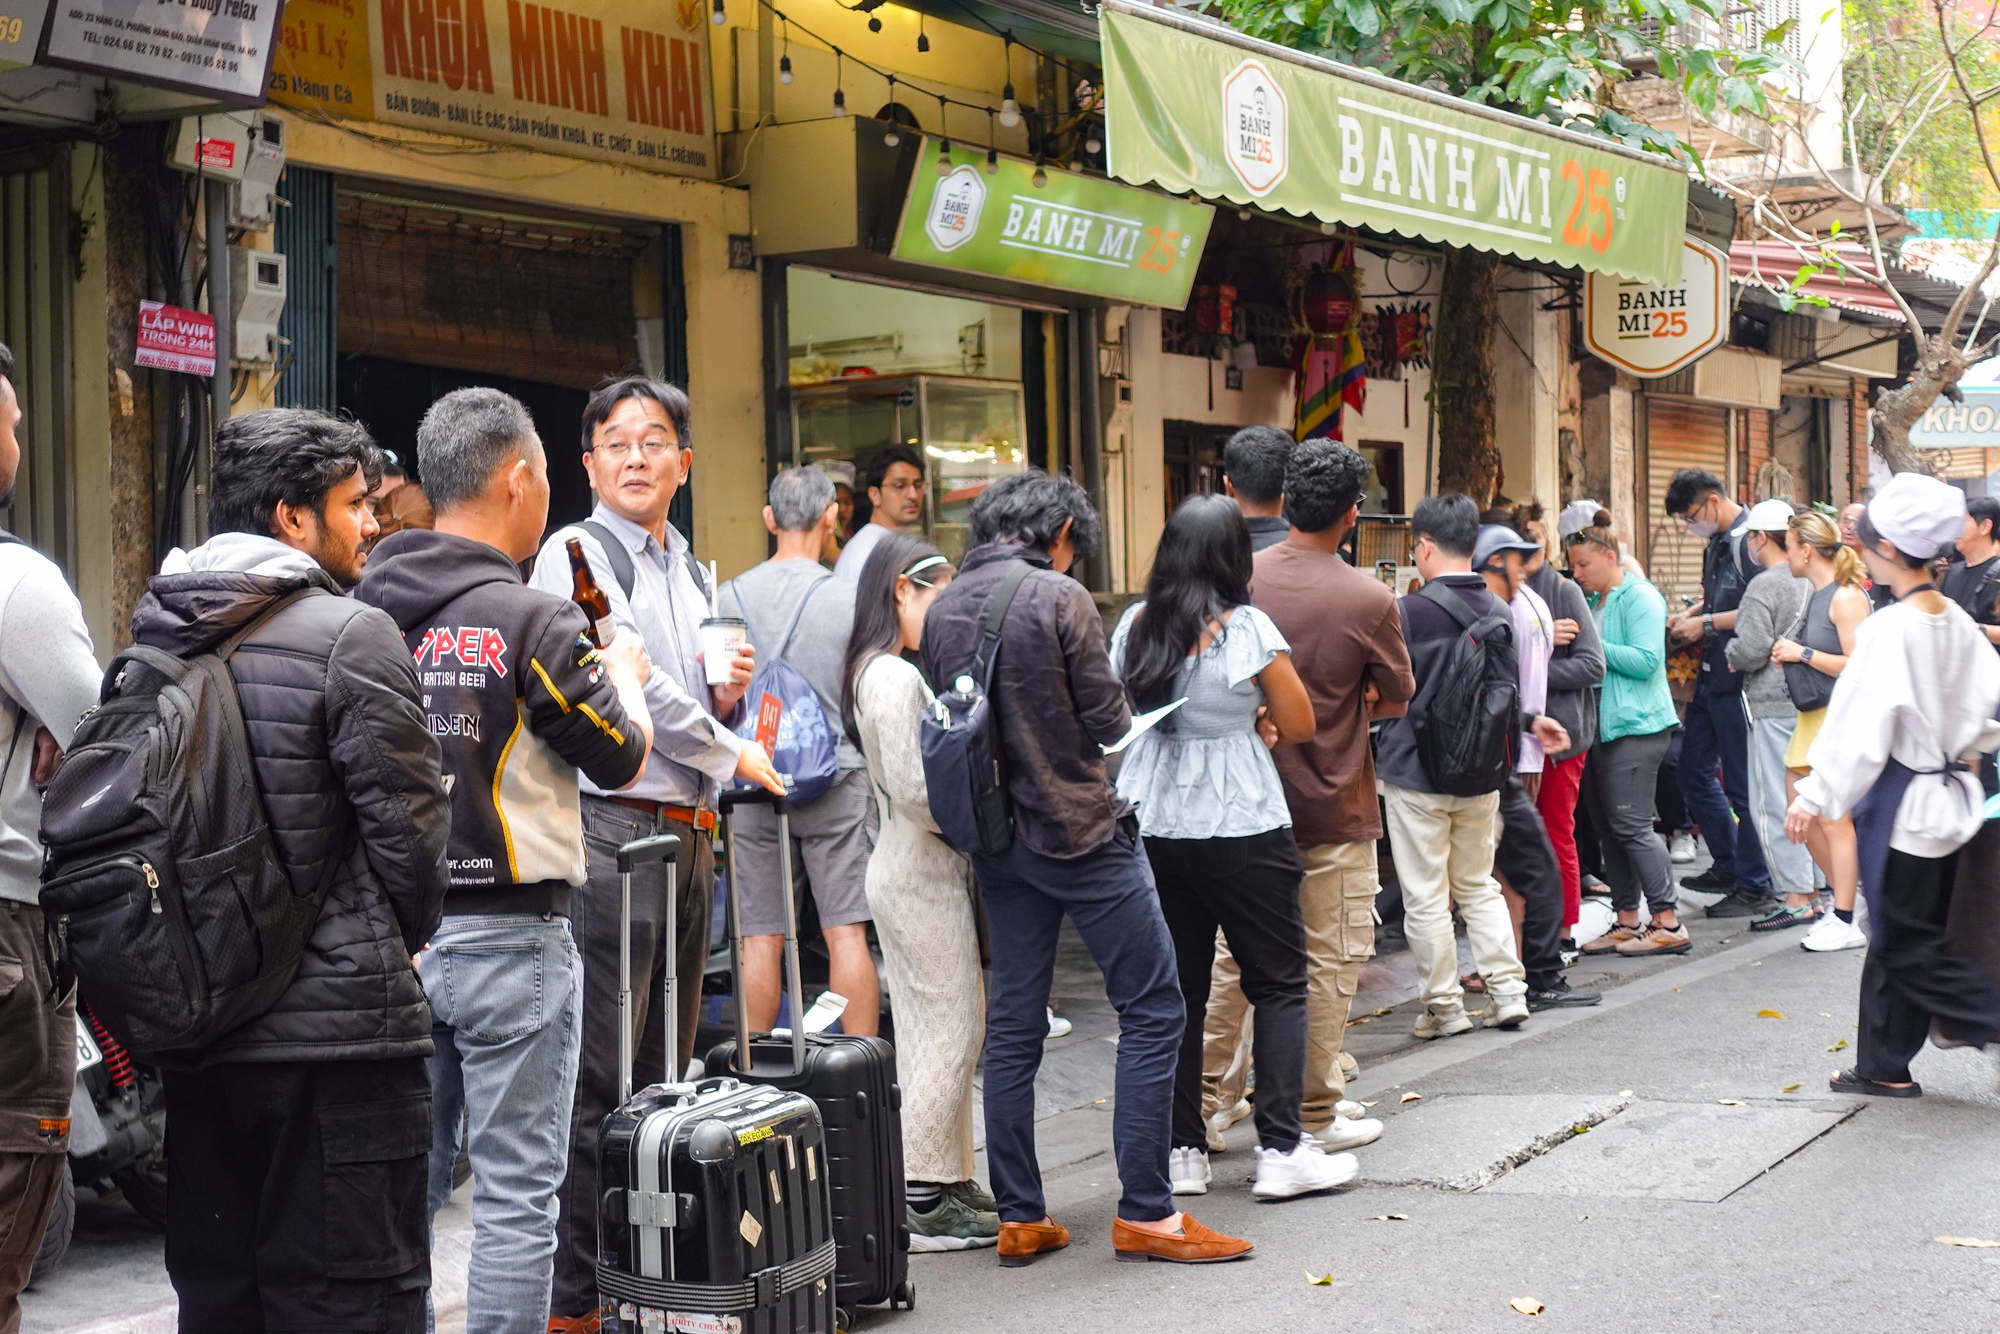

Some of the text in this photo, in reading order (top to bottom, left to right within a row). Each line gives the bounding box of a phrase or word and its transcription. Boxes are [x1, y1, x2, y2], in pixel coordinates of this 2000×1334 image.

[225, 0, 257, 20] relax
[83, 30, 100, 45] TEL:
[279, 19, 308, 59] ại
[506, 0, 609, 117] MINH
[621, 25, 704, 135] KHAI
[269, 72, 288, 91] 25
[1240, 113, 1271, 137] BANH
[1338, 113, 1477, 212] BANH
[1496, 155, 1552, 228] MI
[1561, 158, 1613, 254] 25
[944, 199, 971, 215] BANH
[1001, 203, 1181, 275] BANH MI 25
[1618, 289, 1687, 310] BANH
[141, 328, 186, 347] TRONG
[188, 336, 213, 351] 24H
[178, 320, 213, 339] WIFI
[423, 671, 456, 686] BRITISH
[458, 671, 486, 688] BEER
[422, 694, 432, 708] BY
[763, 702, 778, 731] 041
[427, 713, 480, 742] IDEN
[698, 1321, 738, 1331] CHECKD
